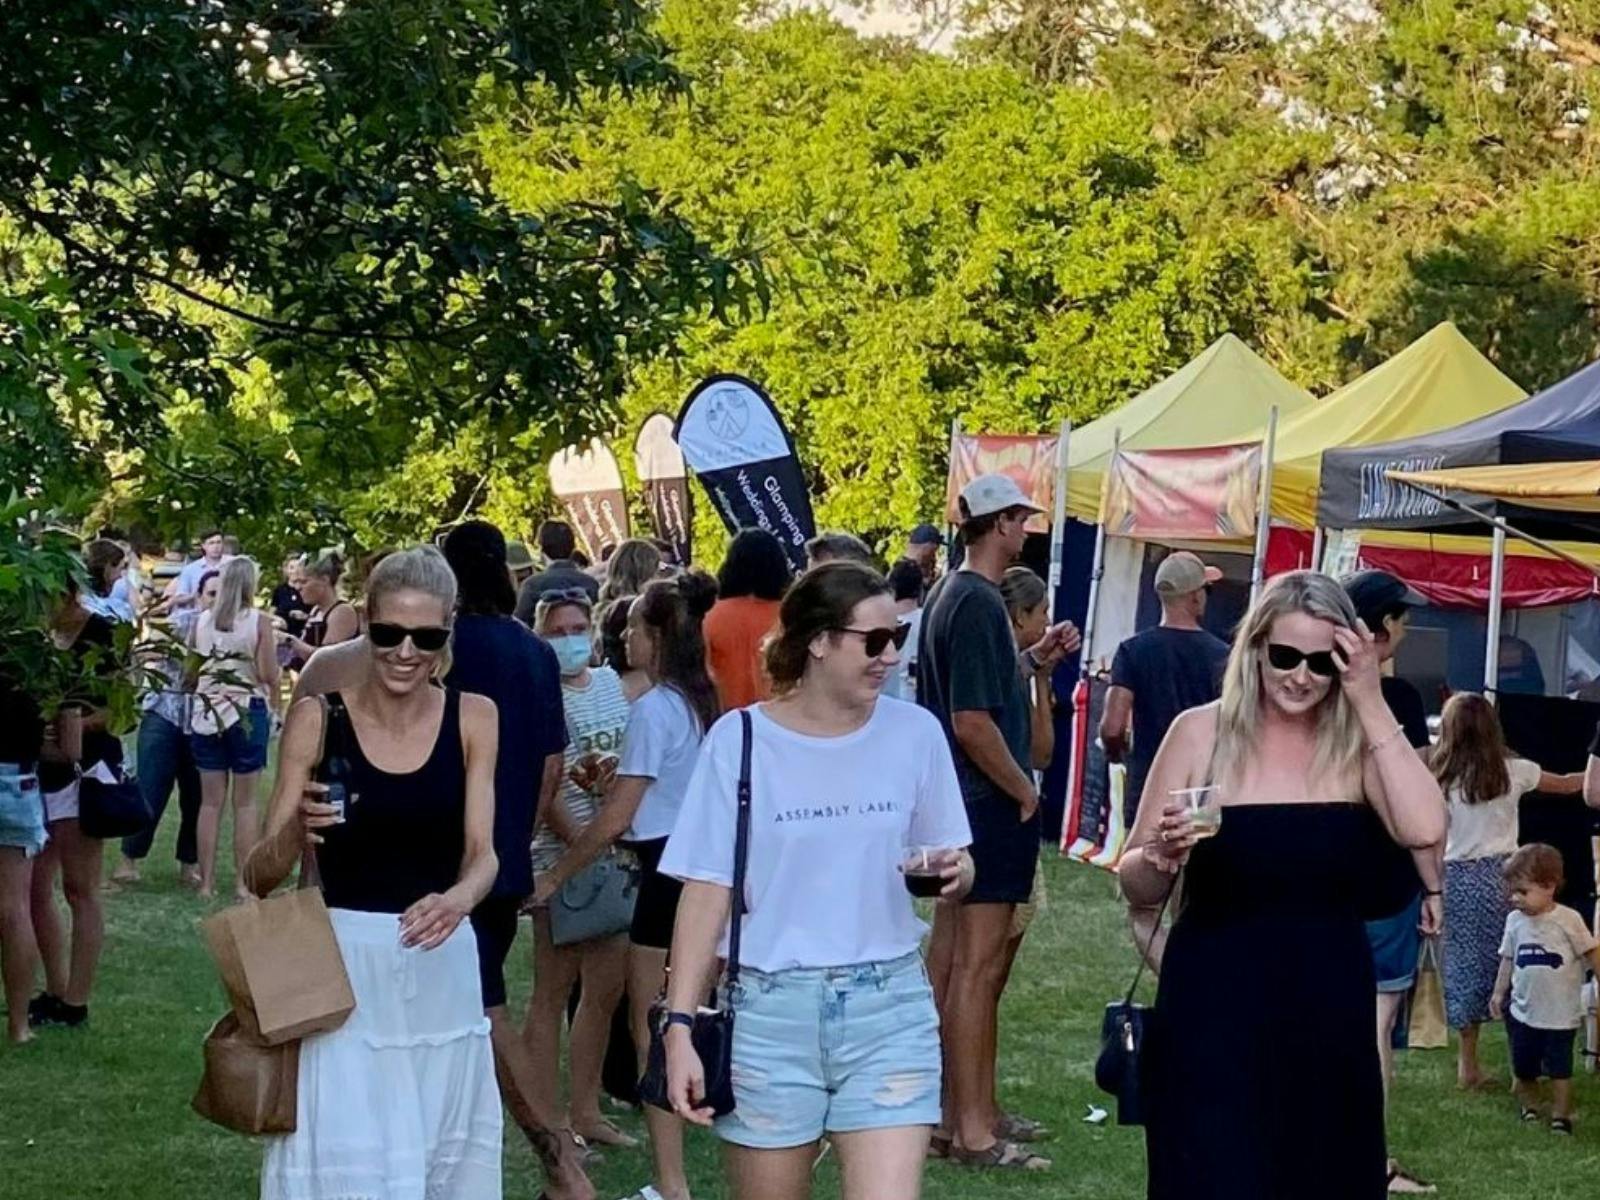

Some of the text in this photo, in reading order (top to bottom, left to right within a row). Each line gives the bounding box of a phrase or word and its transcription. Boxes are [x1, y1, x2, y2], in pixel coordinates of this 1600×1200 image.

[737, 469, 773, 532] Weddings
[763, 475, 804, 546] Glamping
[775, 805, 850, 822] ASSEMBLY
